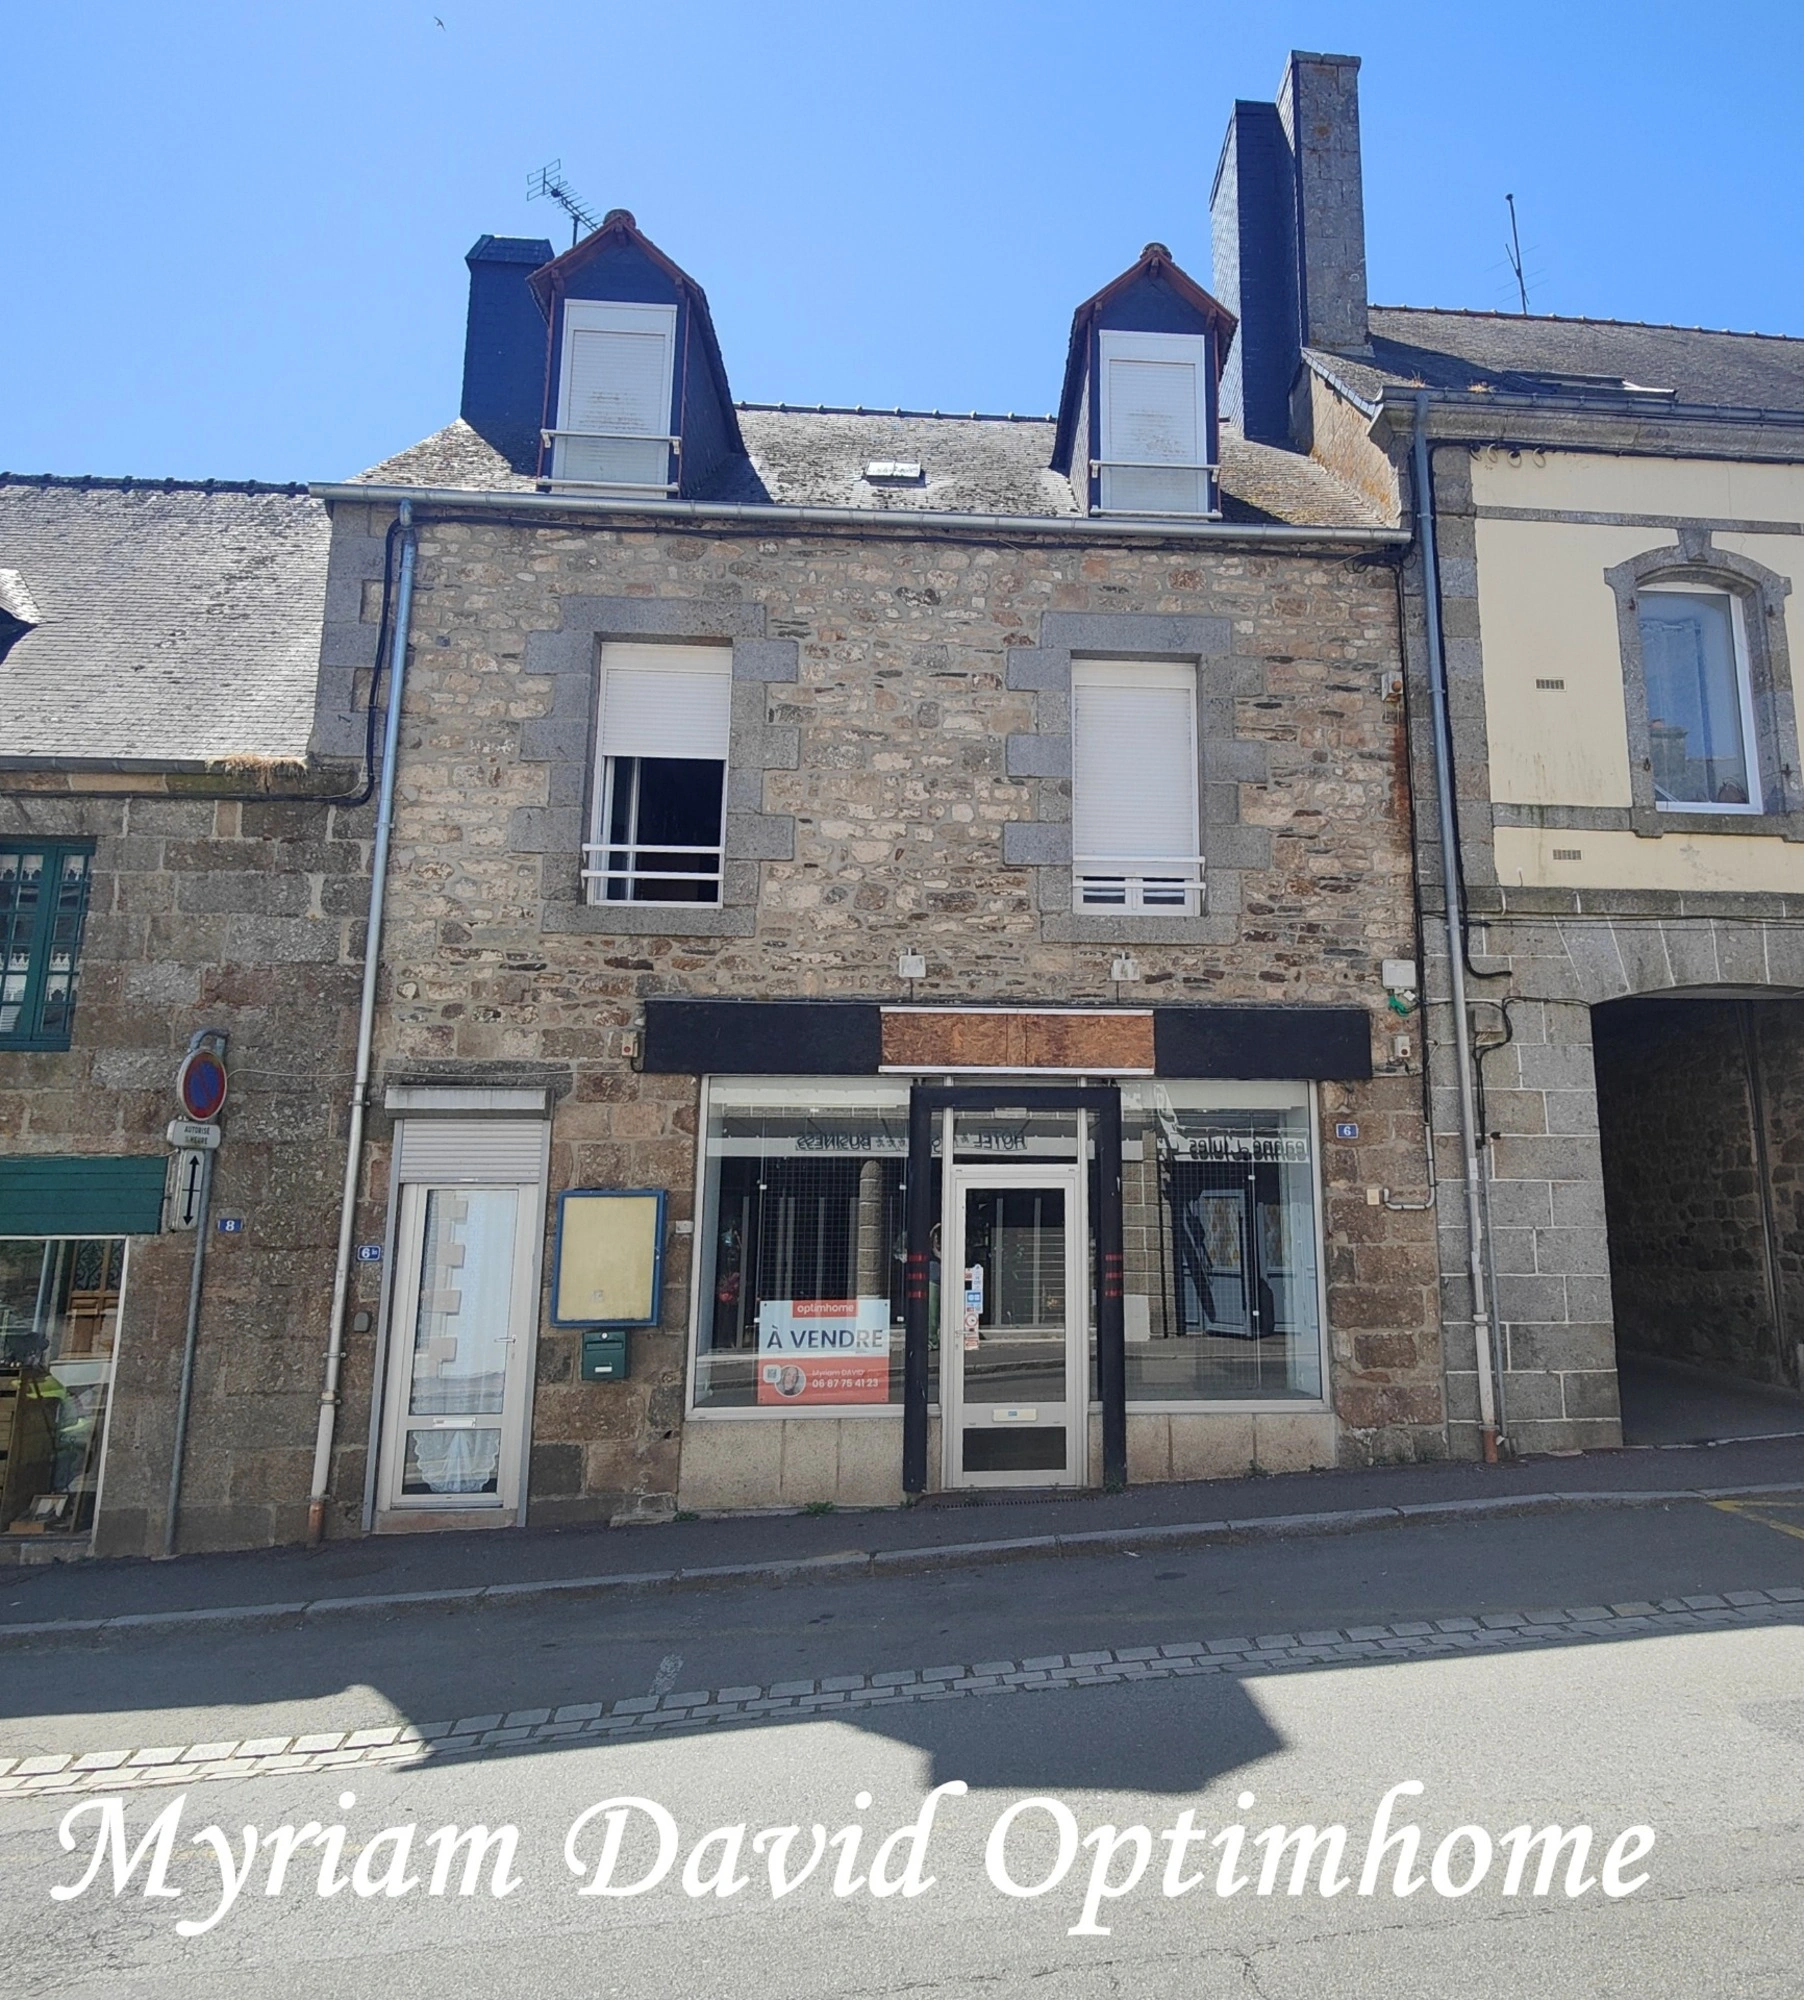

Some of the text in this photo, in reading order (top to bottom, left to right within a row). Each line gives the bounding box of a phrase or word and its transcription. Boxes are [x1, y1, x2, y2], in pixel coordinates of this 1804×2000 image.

[1343, 1126, 1351, 1136] 6
[225, 1220, 235, 1231] 8
[361, 1247, 370, 1258] 6
[797, 1303, 854, 1315] optimhome
[767, 1325, 883, 1348] À VENDRE
[812, 1379, 825, 1388] 06
[827, 1379, 839, 1388] 87
[855, 1379, 865, 1388] 41
[867, 1378, 879, 1387] 23
